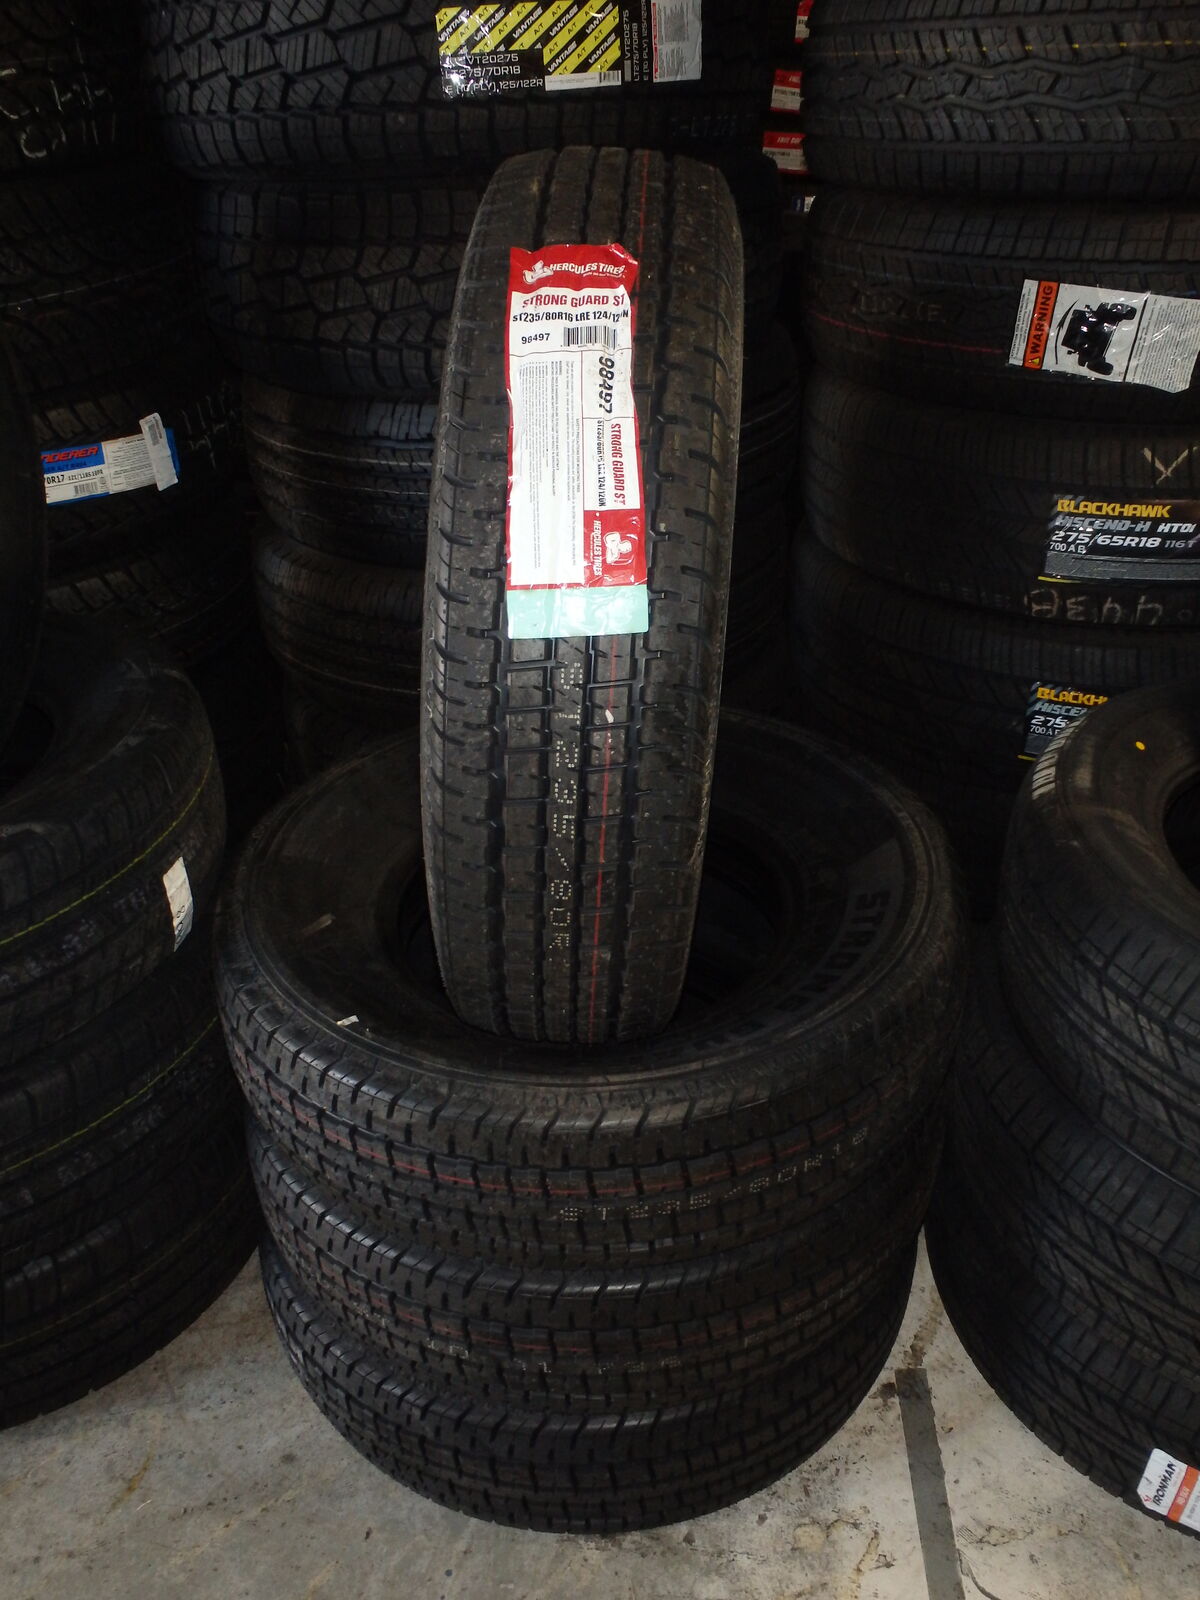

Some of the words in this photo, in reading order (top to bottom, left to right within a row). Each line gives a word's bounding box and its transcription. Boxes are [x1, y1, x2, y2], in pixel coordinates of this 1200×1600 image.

[622, 9, 631, 60] VT20275
[466, 53, 519, 65] VT20275
[550, 262, 596, 274] HERCULES
[598, 262, 626, 275] TIRES
[522, 294, 567, 309] STRONG
[571, 294, 609, 308] GUARD
[612, 293, 626, 307] ST
[512, 311, 573, 324] ST235/80R16
[575, 311, 591, 322] LRE
[593, 309, 629, 324] 124/12N
[1029, 284, 1054, 355] WARNING
[521, 332, 551, 345] 98497
[610, 422, 623, 460] STRONG
[612, 461, 626, 493] GUARD
[1057, 498, 1173, 519] BLACKHAWK
[594, 520, 602, 556] HERCULES
[1050, 542, 1066, 551] 700
[1068, 544, 1076, 553] A
[1051, 530, 1162, 549] 275/65R18
[1152, 1460, 1177, 1506] IRONMAN
